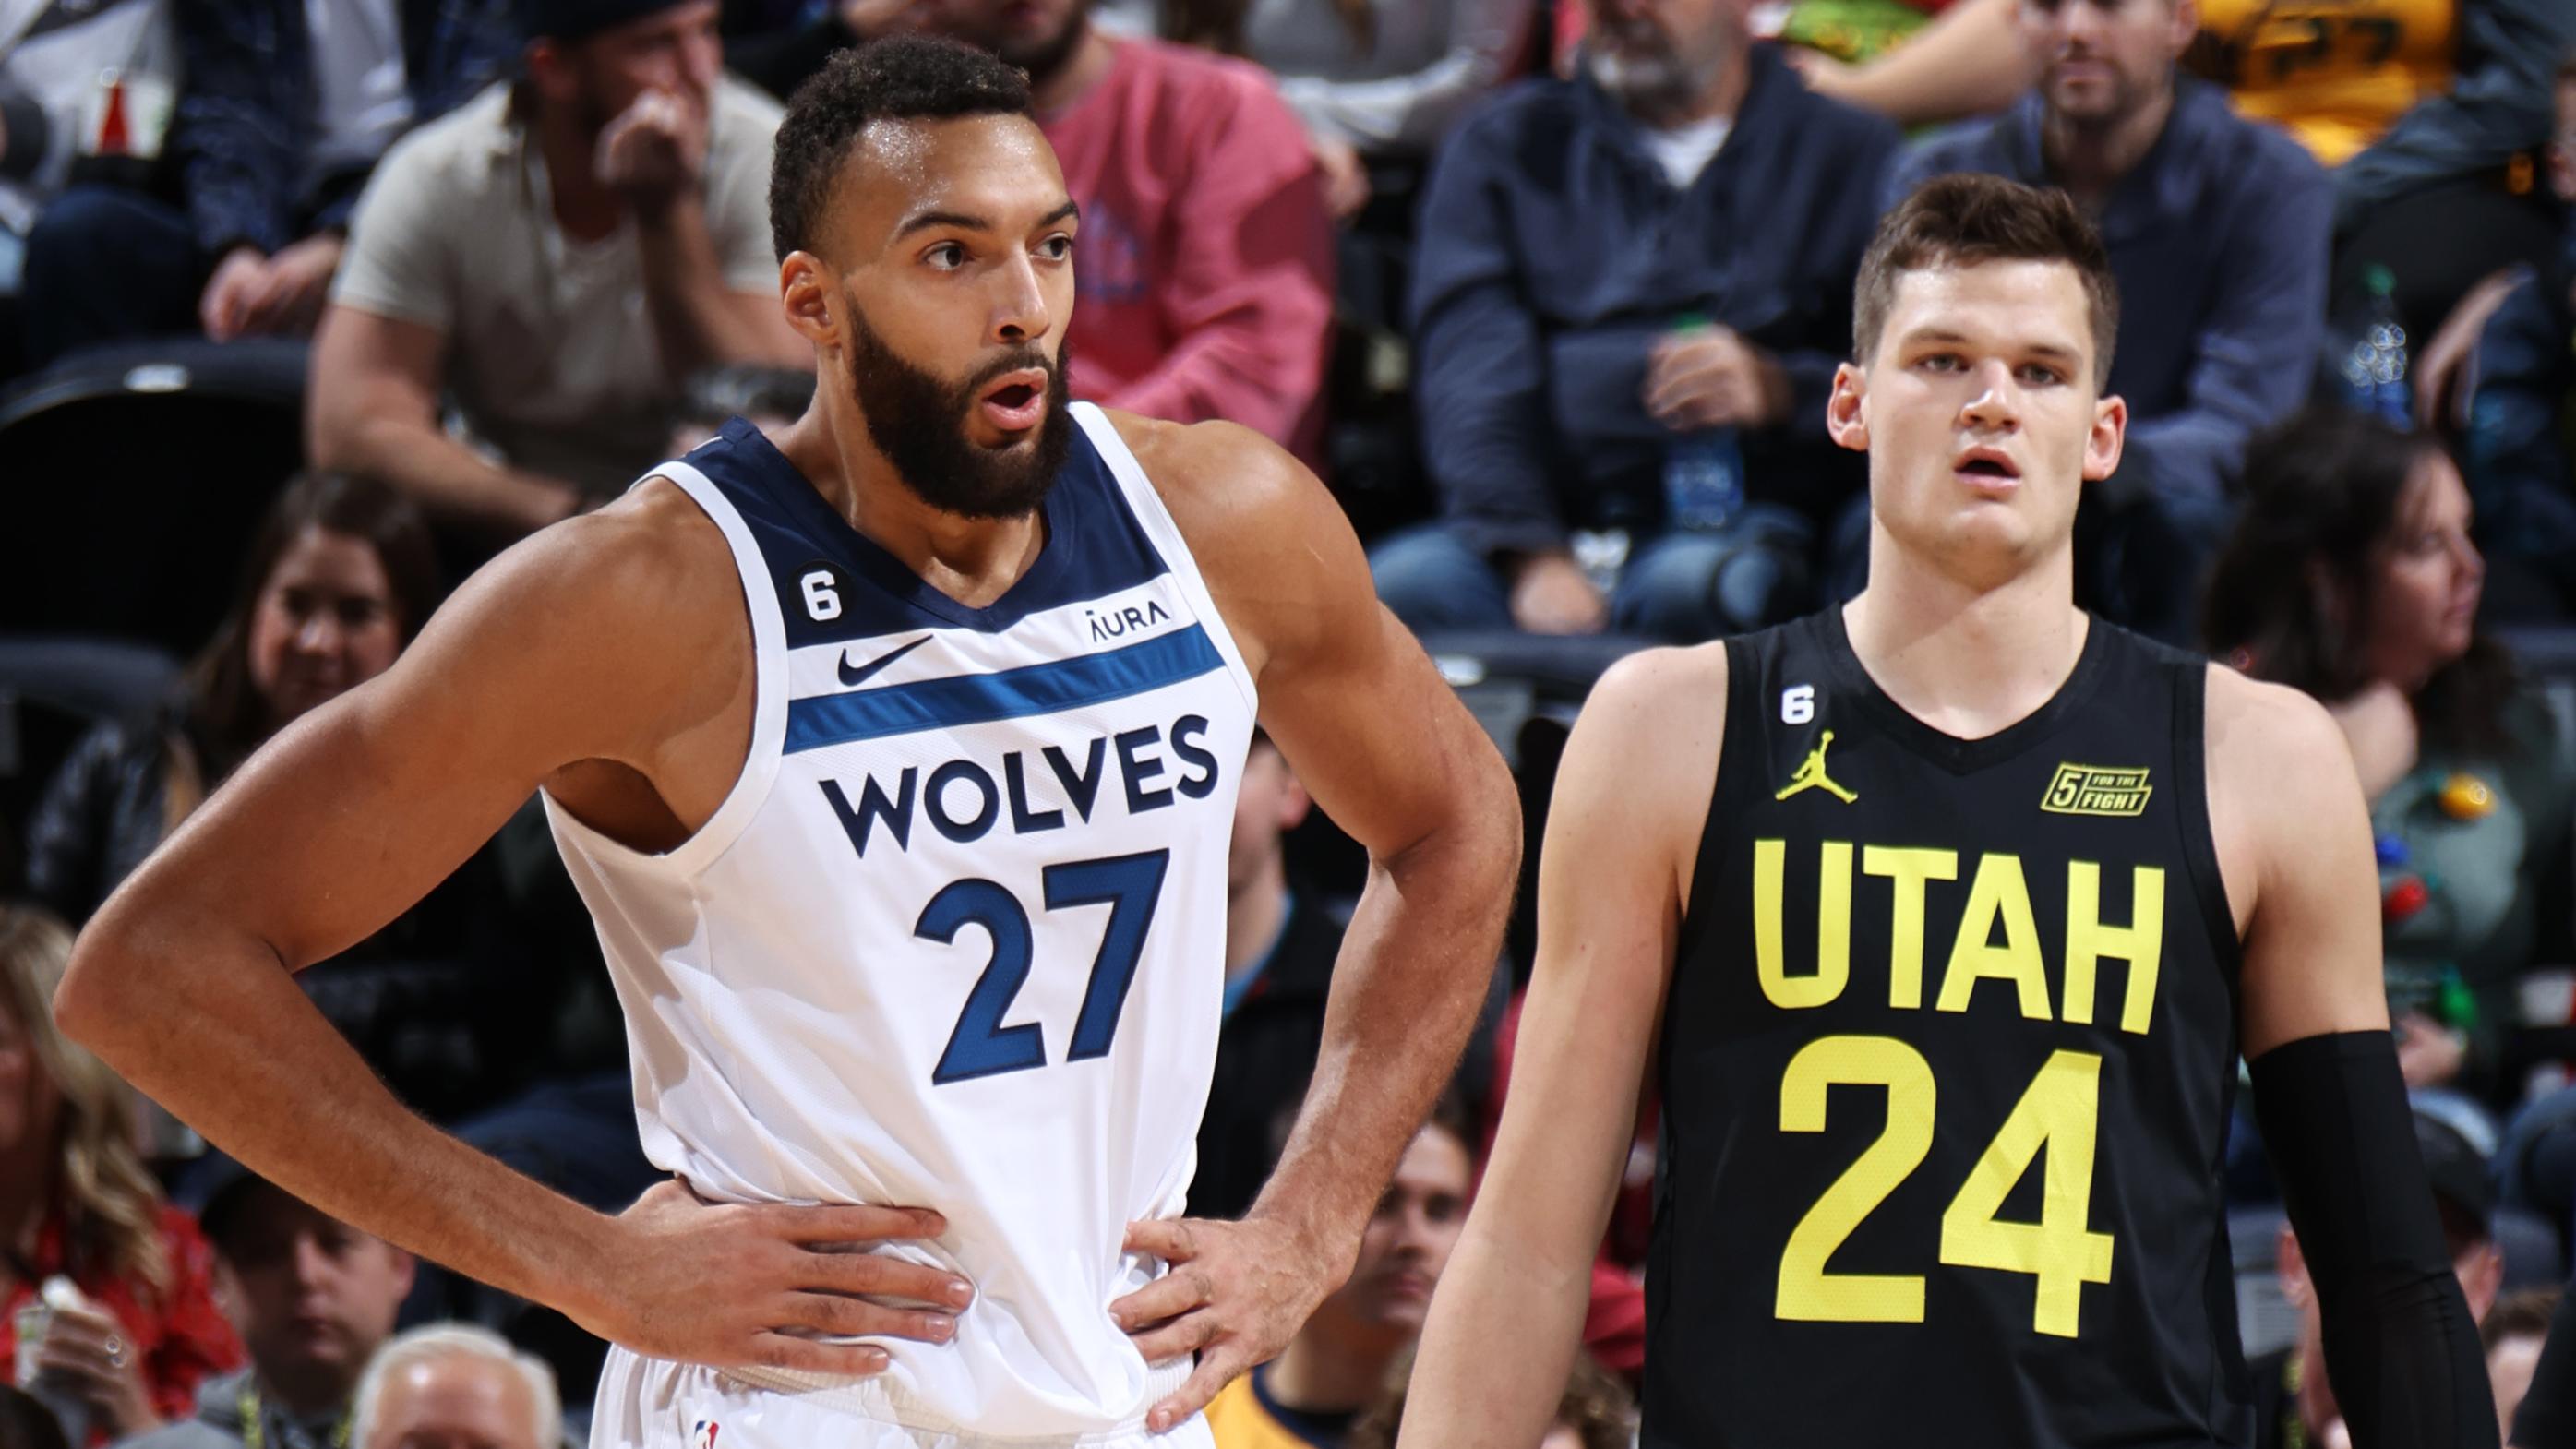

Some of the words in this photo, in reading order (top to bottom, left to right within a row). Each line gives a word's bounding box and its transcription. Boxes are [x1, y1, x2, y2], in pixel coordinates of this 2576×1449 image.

[801, 570, 842, 621] 6
[1781, 684, 1815, 724] 6
[818, 714, 1218, 859] WOLVES
[2052, 772, 2083, 807] 5
[2081, 792, 2141, 809] FIGHT
[2091, 774, 2115, 786] FOR
[2115, 775, 2138, 787] THE
[1754, 839, 2165, 1036] UTAH
[913, 847, 1170, 1086] 27
[1774, 1035, 2115, 1339] 24
